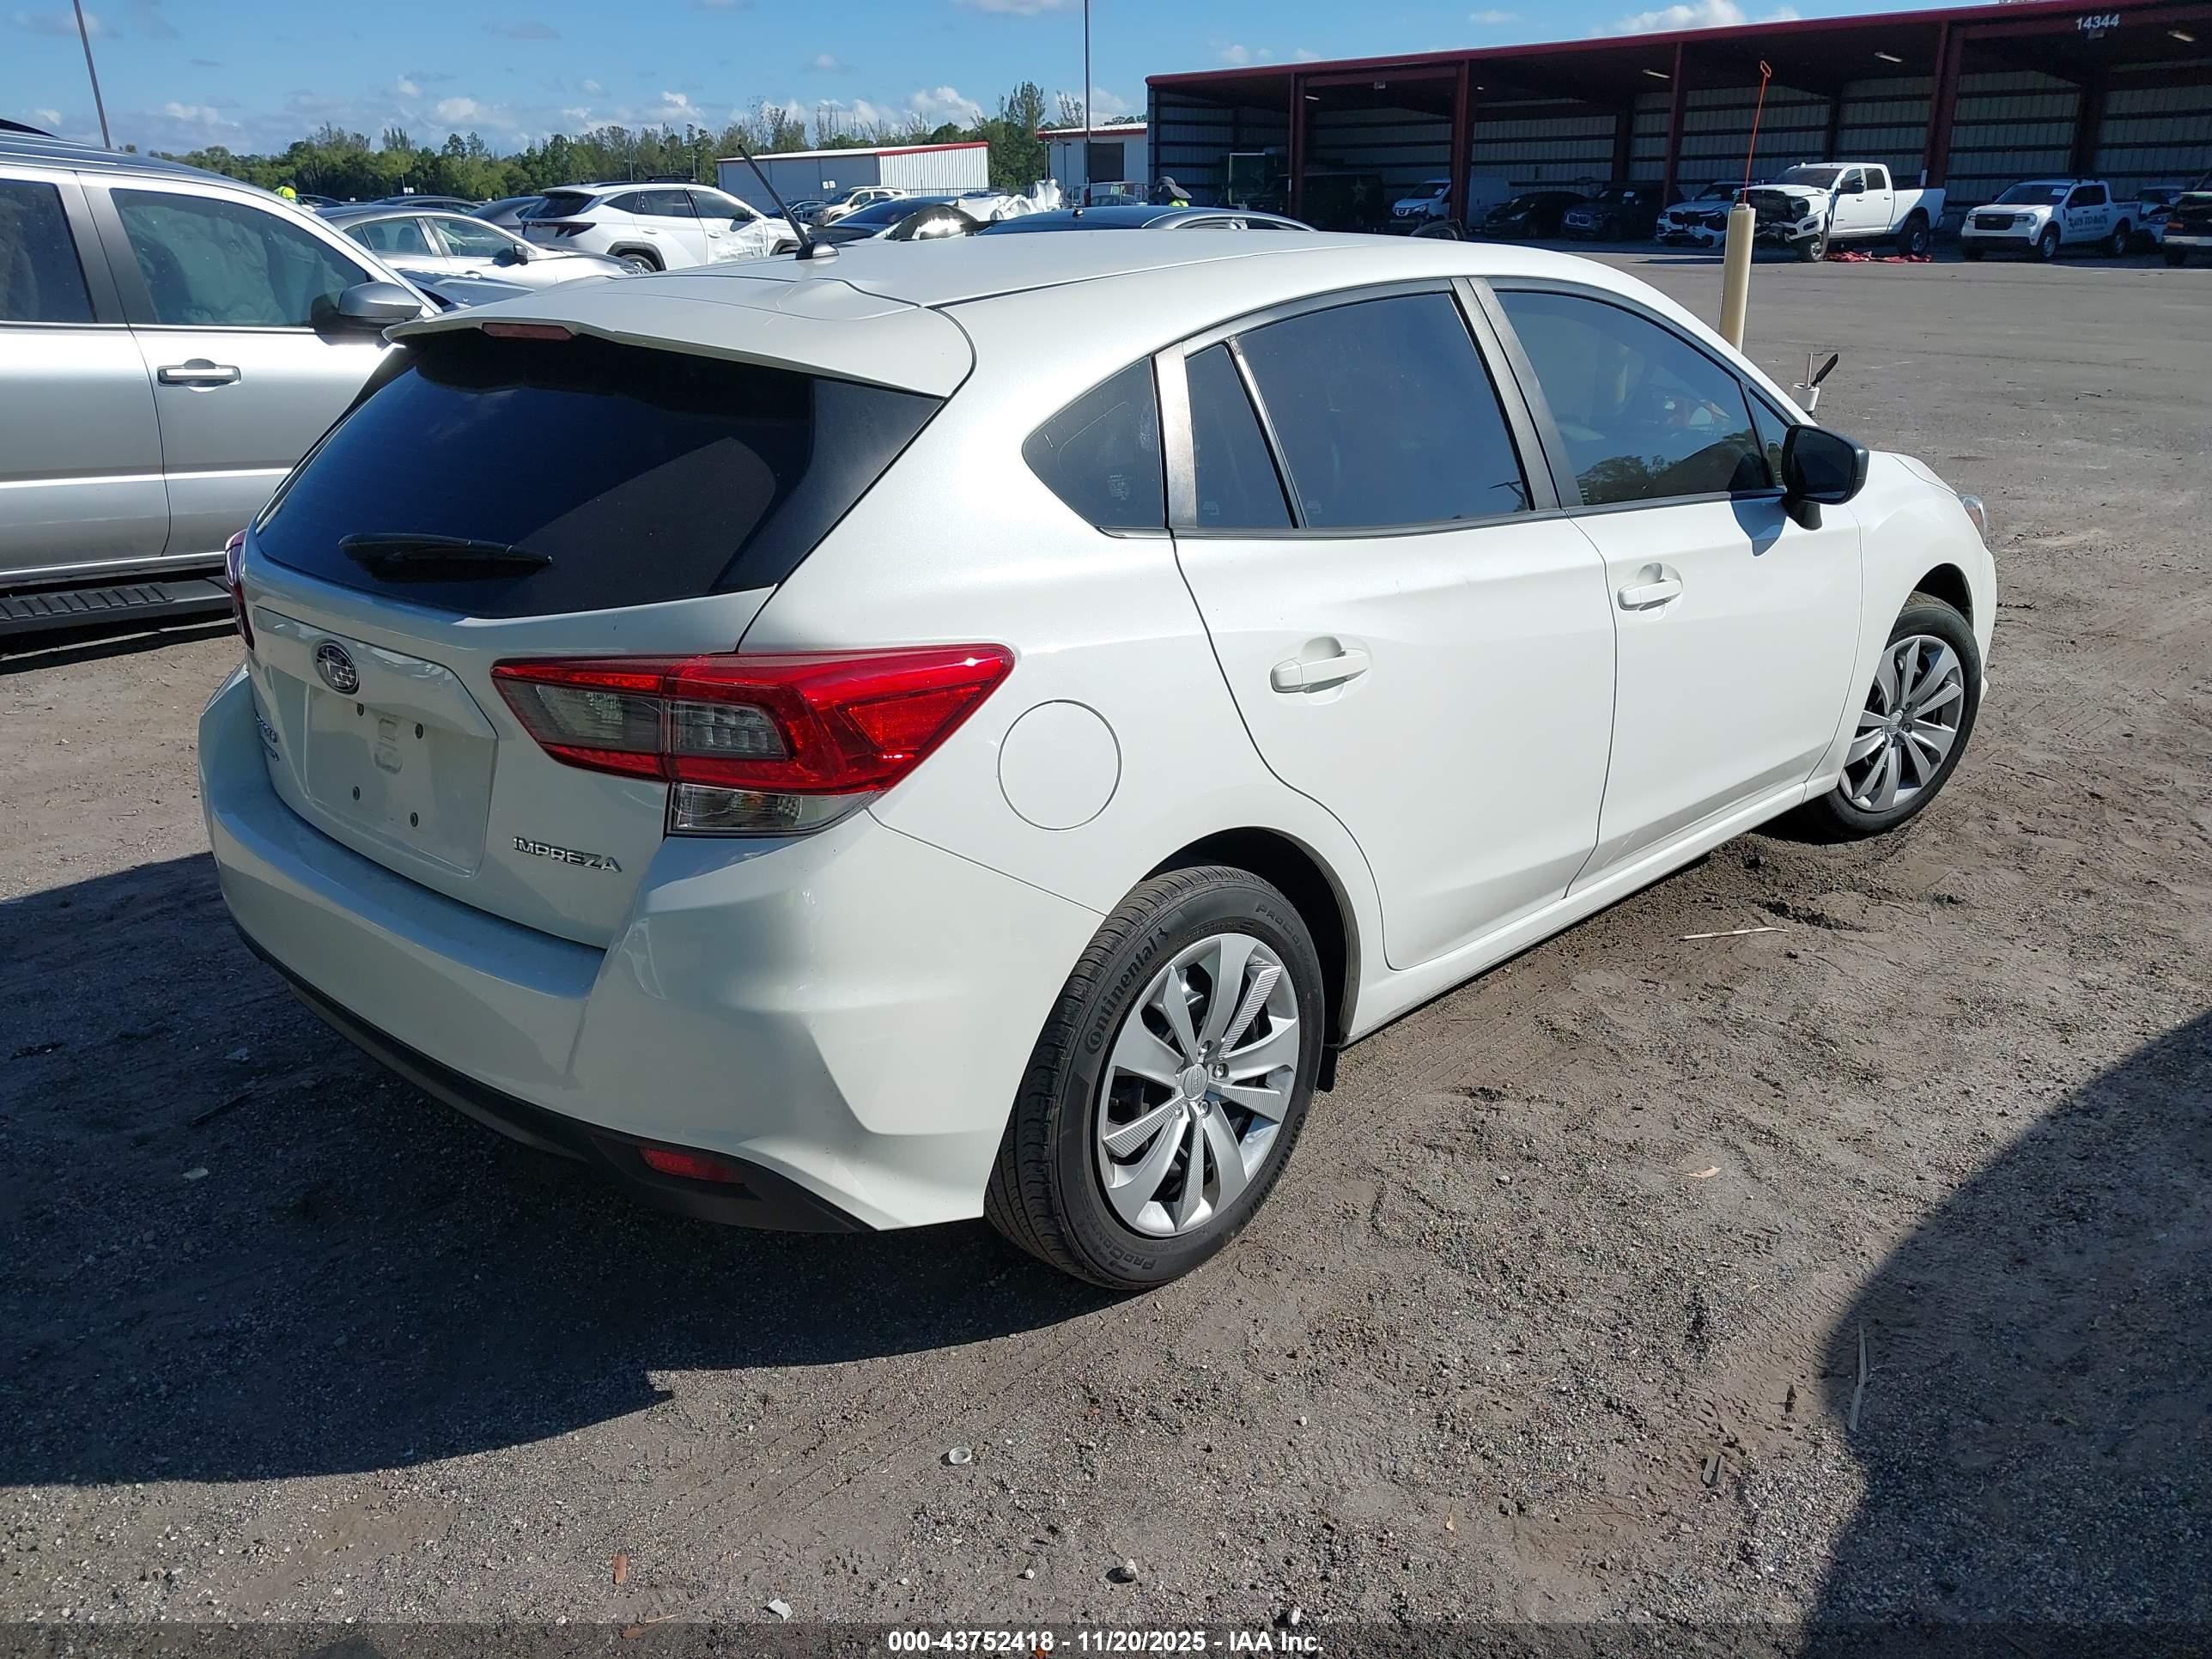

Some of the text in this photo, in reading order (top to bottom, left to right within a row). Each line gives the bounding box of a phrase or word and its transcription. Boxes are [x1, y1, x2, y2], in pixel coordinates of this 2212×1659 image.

[2075, 14, 2120, 30] 14344
[513, 836, 623, 872] IMPREZA
[1085, 935, 1158, 1055] Continental
